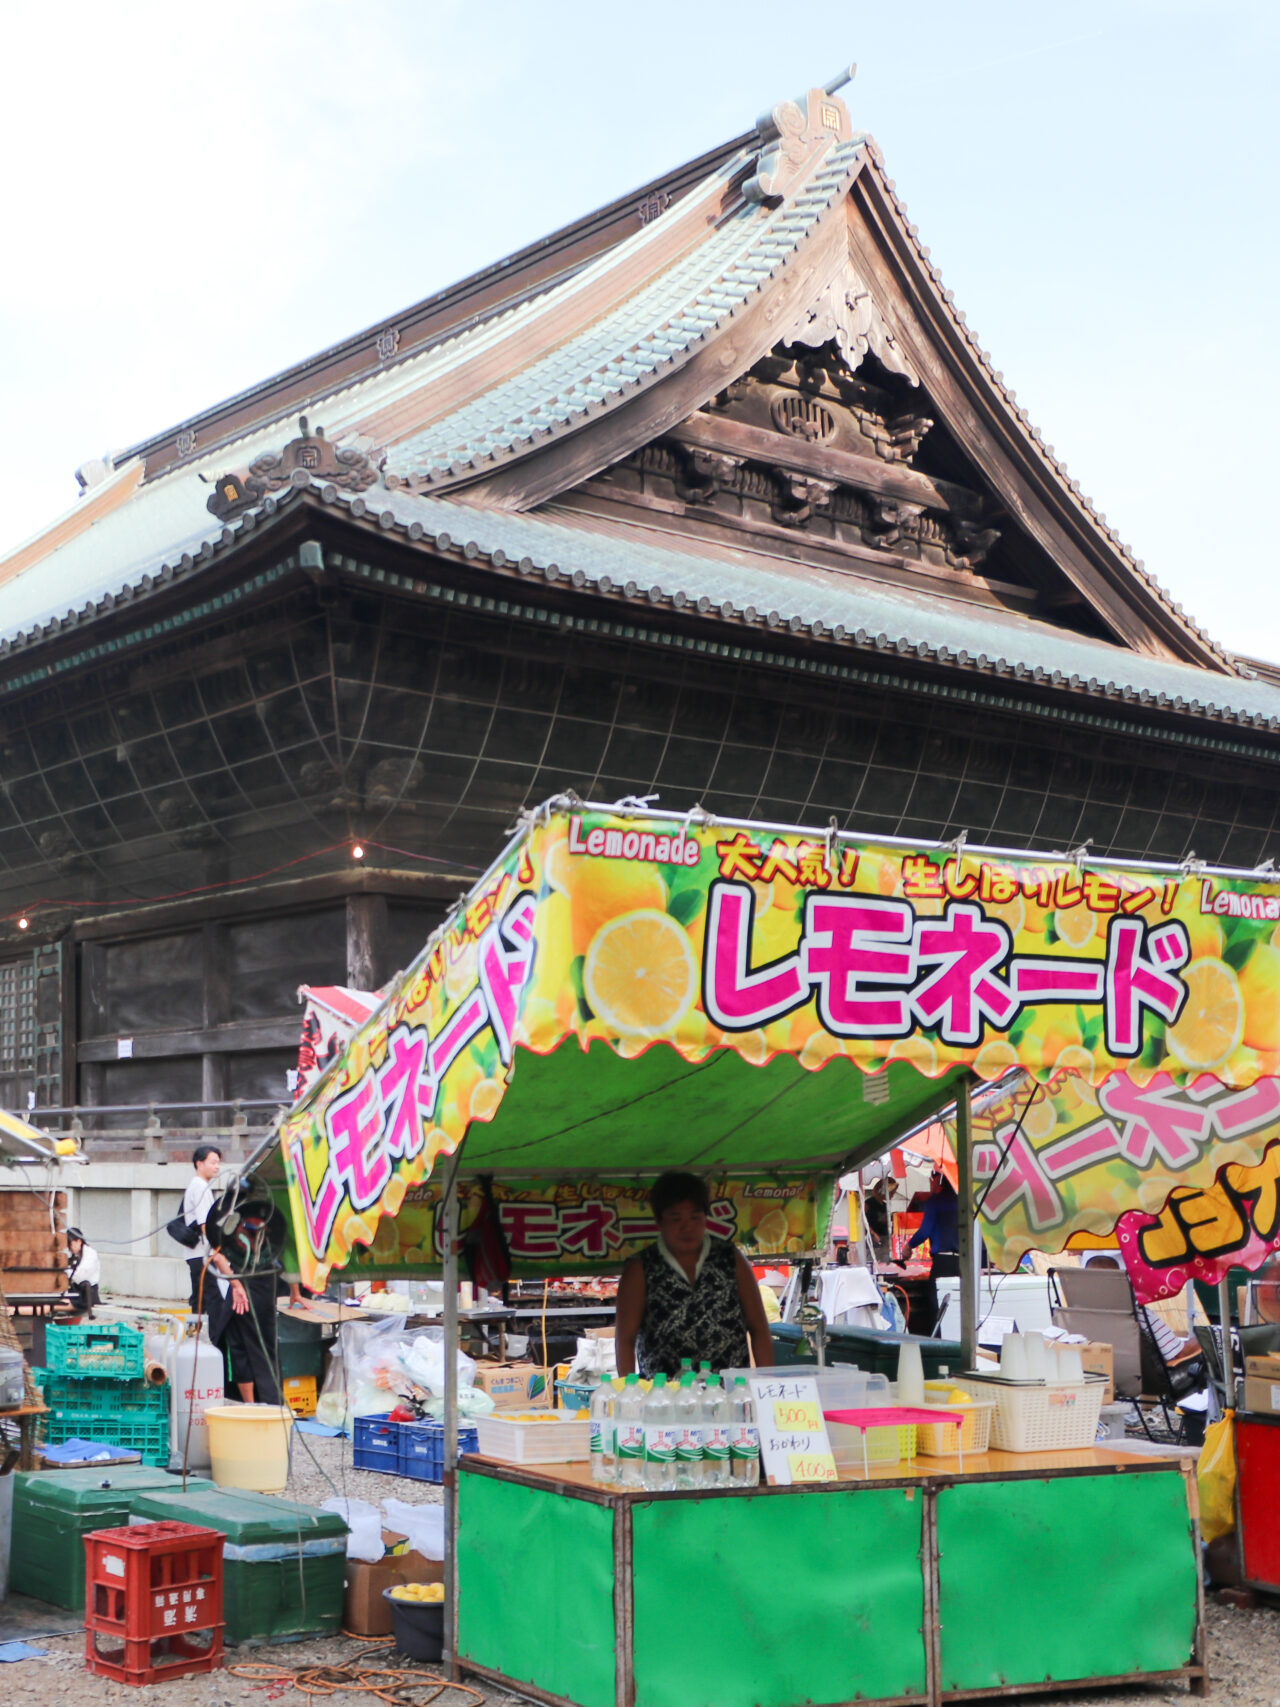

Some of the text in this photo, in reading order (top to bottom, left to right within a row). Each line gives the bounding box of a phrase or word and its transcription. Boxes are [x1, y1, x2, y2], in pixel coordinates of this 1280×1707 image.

[569, 815, 701, 866] Lemonade
[716, 832, 861, 889] 大人気！
[902, 855, 1179, 914] 生しぼりレモン！
[703, 877, 1191, 1058] レモネード
[290, 890, 538, 1260] レモネード
[758, 1384, 808, 1400] レモネード
